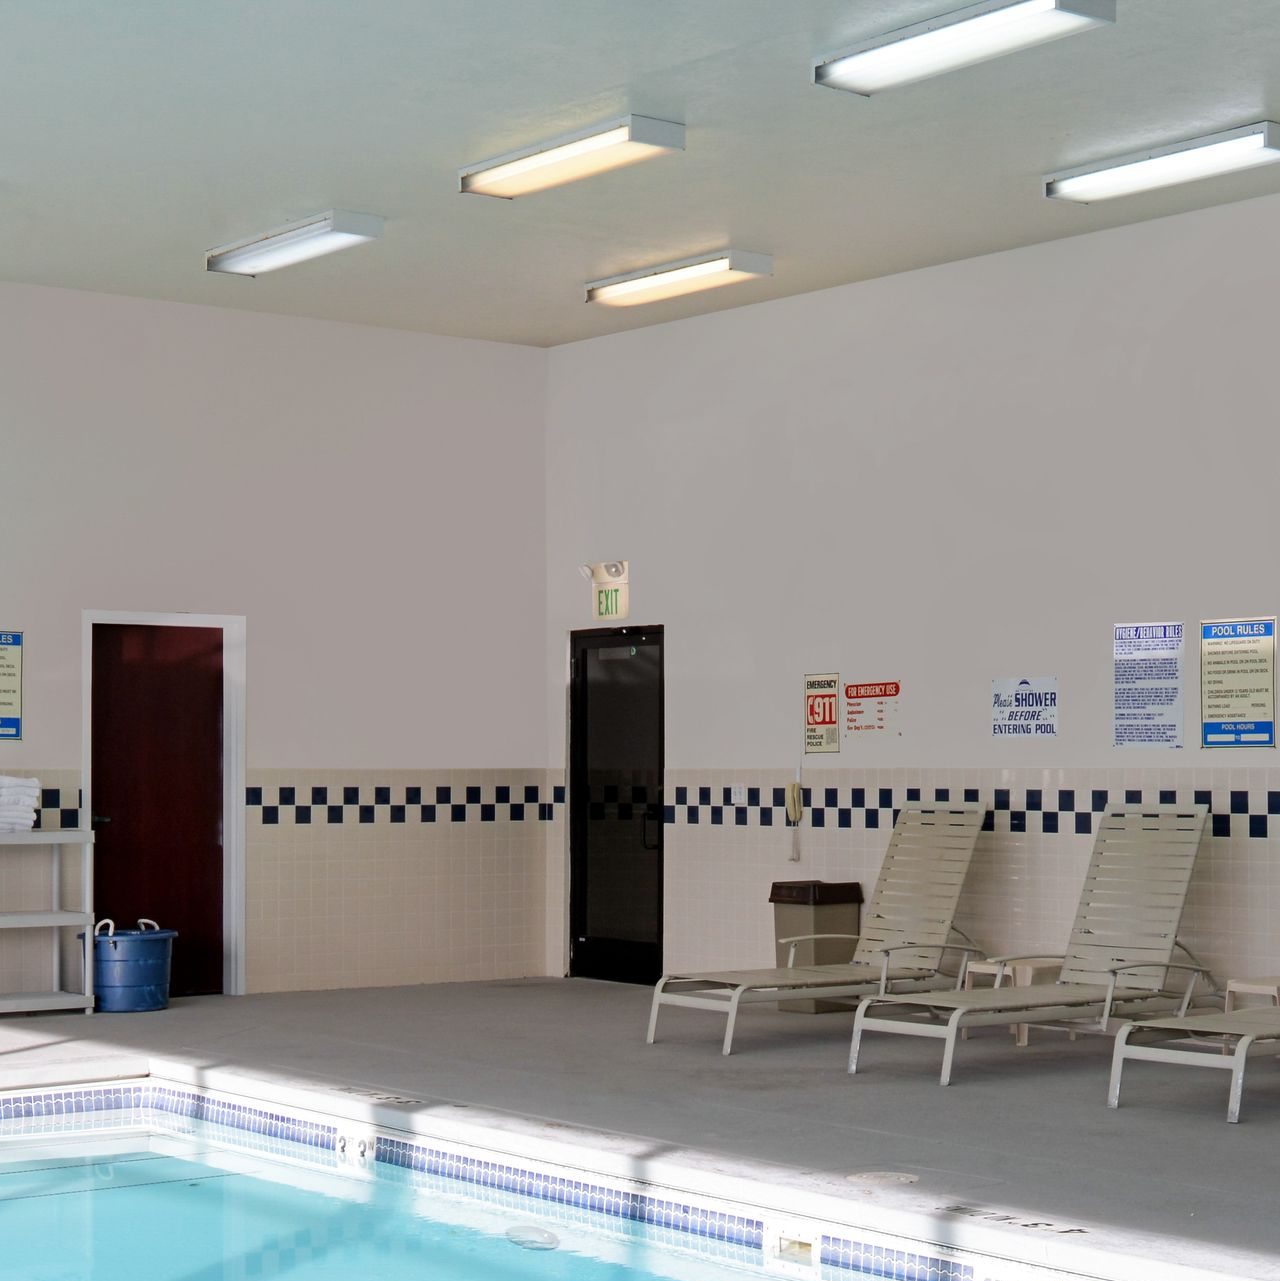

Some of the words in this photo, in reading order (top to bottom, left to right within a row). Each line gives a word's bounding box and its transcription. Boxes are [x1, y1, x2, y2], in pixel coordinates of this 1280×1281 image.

[597, 588, 620, 616] EXIT
[1211, 626, 1235, 636] POOL
[1237, 624, 1265, 635] RULES
[806, 679, 837, 689] EMERGENCY
[848, 687, 857, 697] FOR
[858, 685, 885, 696] EMERGENCY
[886, 684, 897, 695] USE
[993, 693, 1013, 708] Please
[1015, 692, 1057, 707] SHOWER
[813, 696, 837, 723] 911
[1008, 710, 1042, 721] BEFORE
[993, 724, 1031, 734] ENTERING
[1035, 723, 1057, 734] POOL
